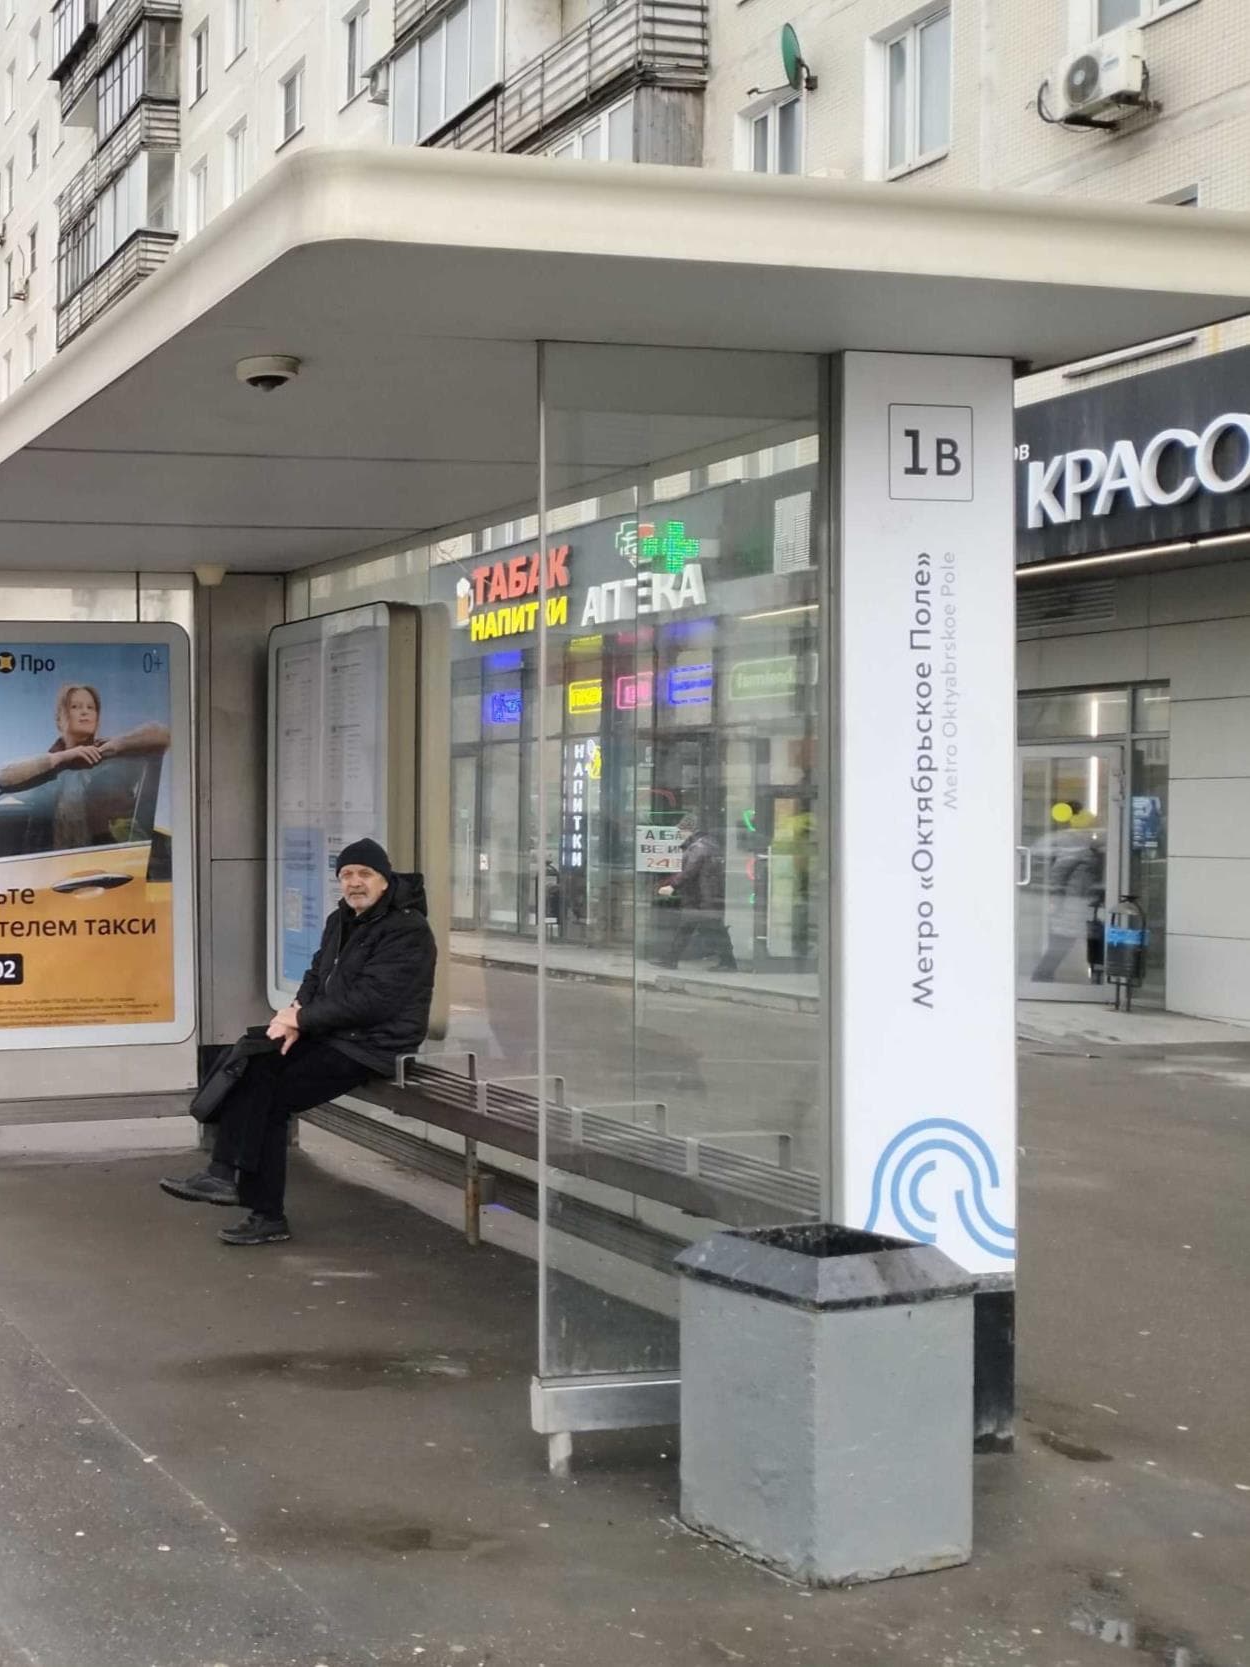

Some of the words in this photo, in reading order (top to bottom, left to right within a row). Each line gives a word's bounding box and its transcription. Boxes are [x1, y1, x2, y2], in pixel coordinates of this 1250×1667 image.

[1027, 413, 1250, 529] КРАСО
[472, 544, 570, 607] ТАБАК
[909, 552, 931, 650] Поле»
[940, 551, 956, 597] Pole
[20, 654, 55, 674] Про
[142, 653, 163, 673] 0+
[940, 604, 959, 738] Oktyabrskoe
[571, 743, 585, 866] НАПИТКИ
[910, 662, 938, 890] «Октябрьское
[943, 745, 958, 810] Metro
[84, 918, 156, 935] такси
[912, 900, 939, 1009] Метро
